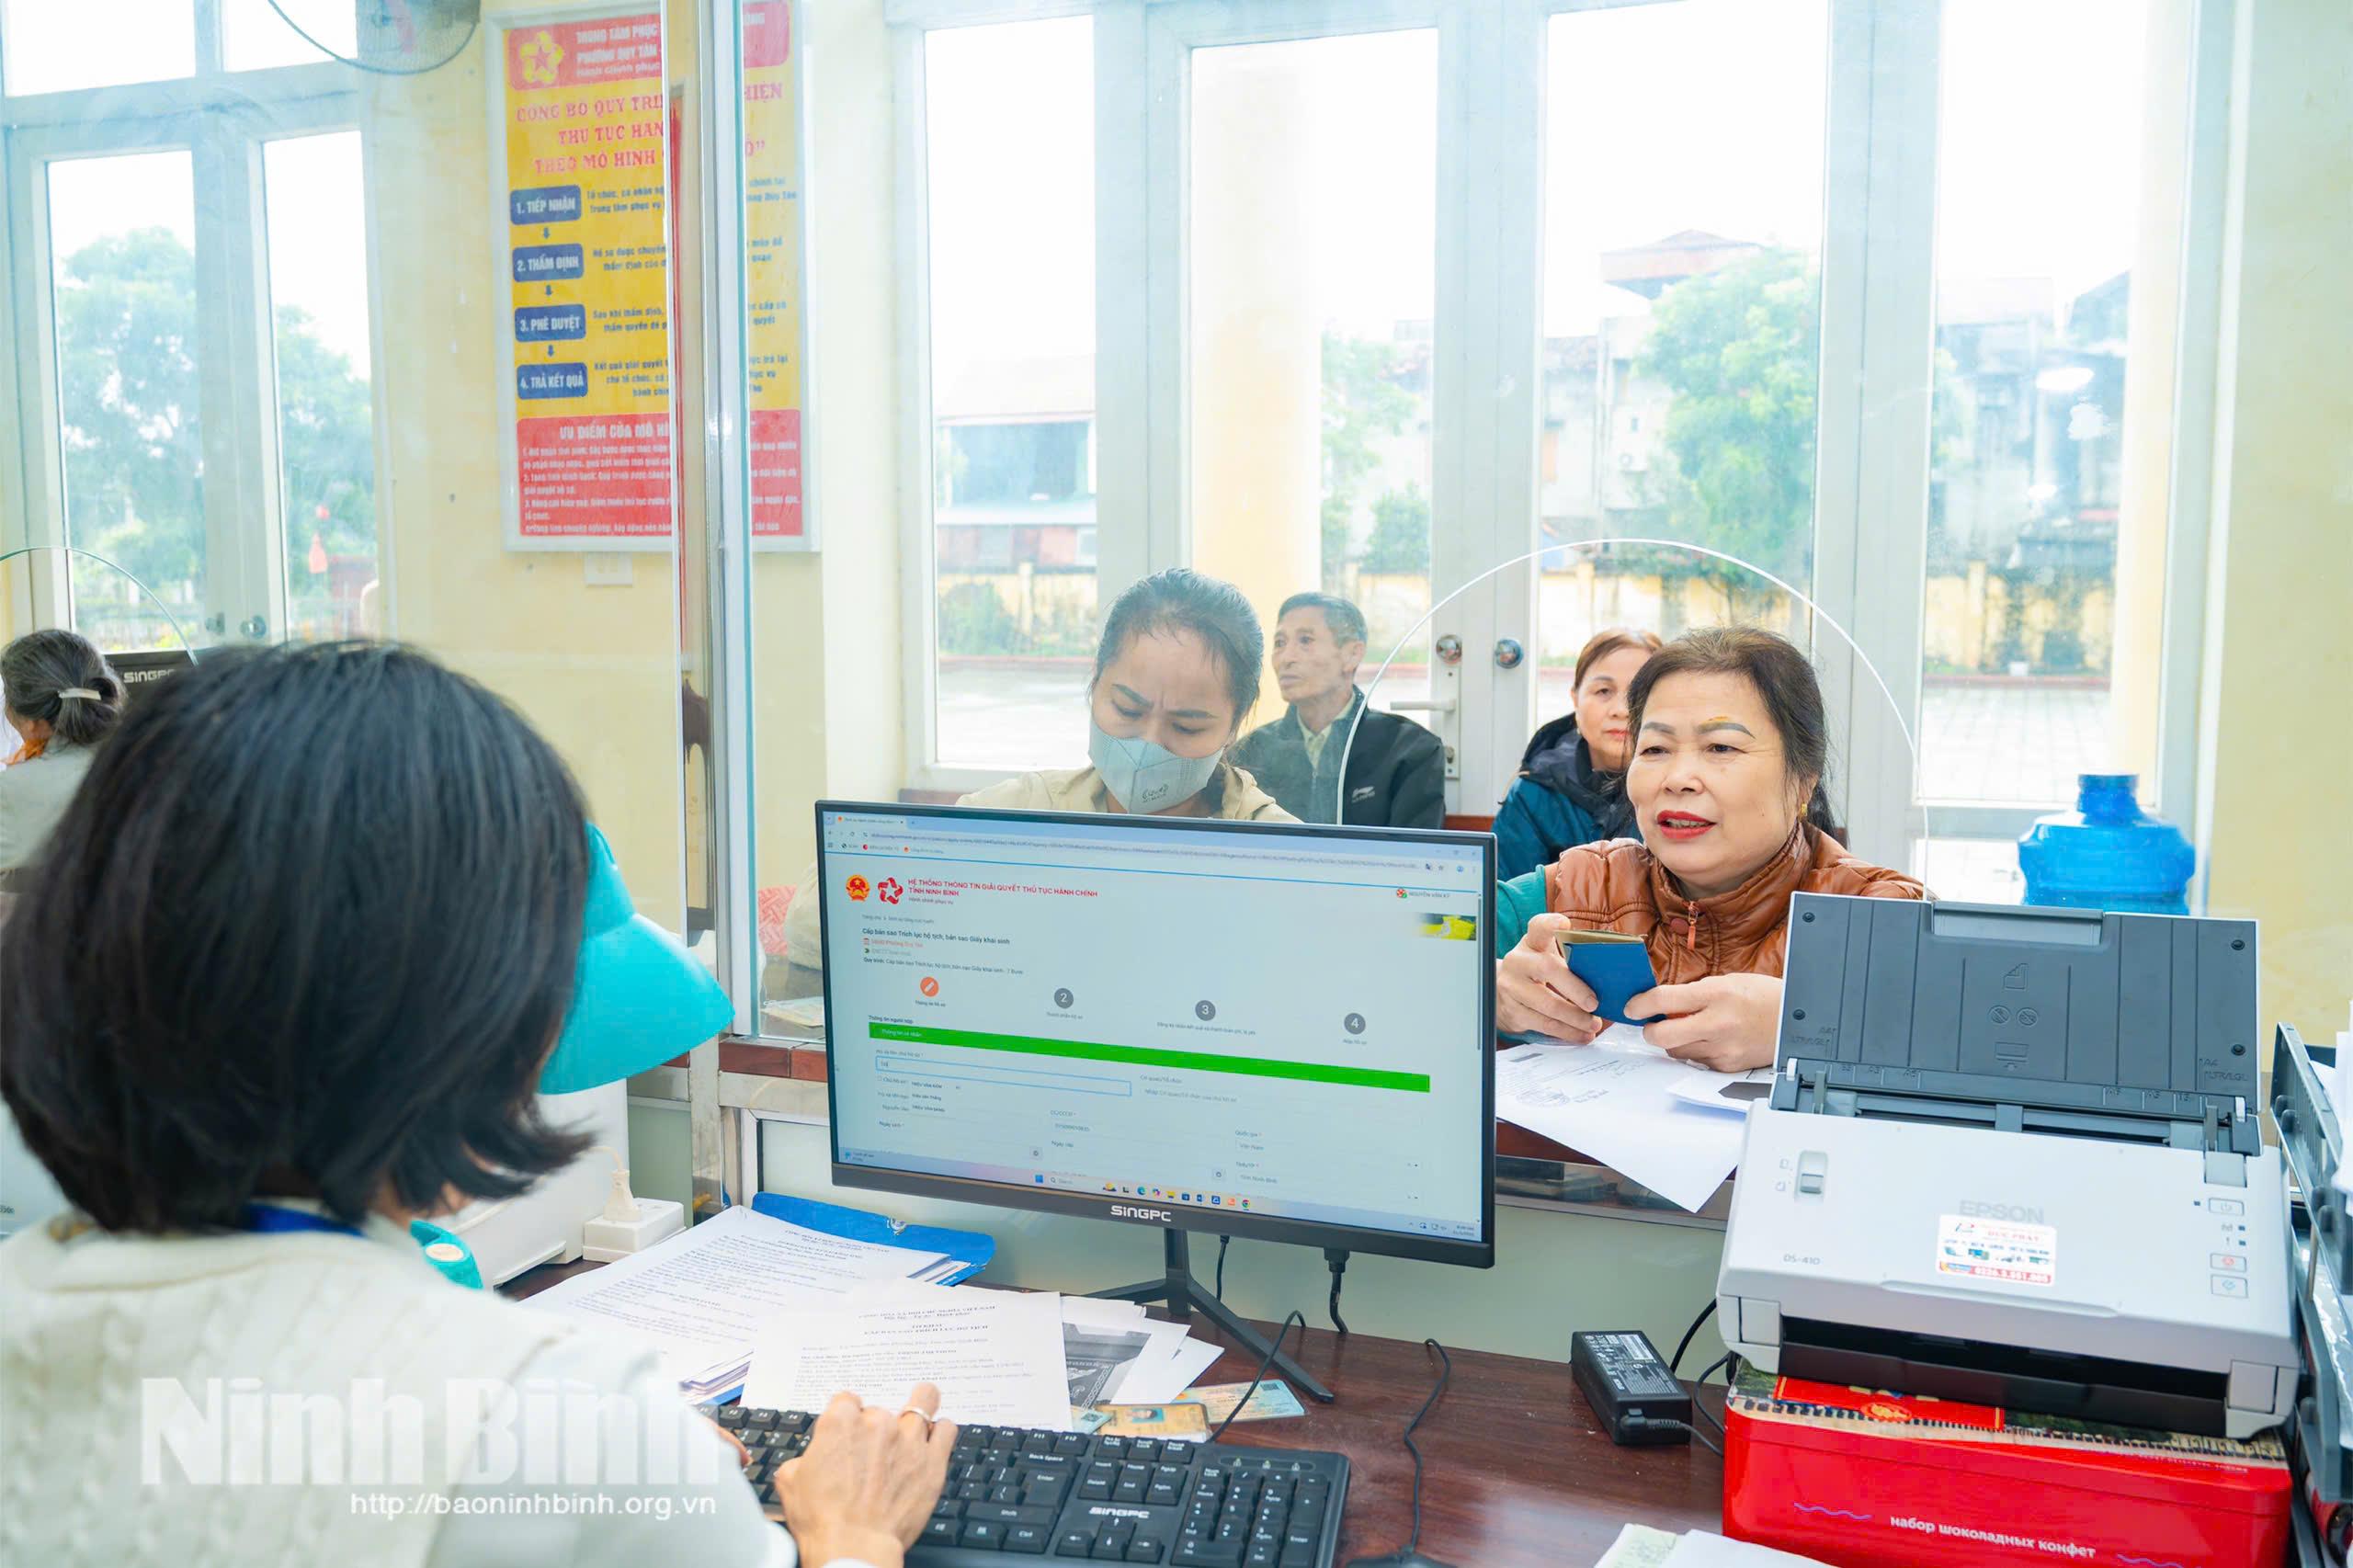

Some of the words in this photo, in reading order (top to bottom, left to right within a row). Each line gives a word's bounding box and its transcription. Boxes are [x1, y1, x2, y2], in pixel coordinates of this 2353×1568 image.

[527, 197, 547, 214] TIẾP
[549, 196, 576, 212] NHẬN
[517, 260, 527, 273] 2.
[519, 320, 529, 333] 3.
[566, 369, 585, 388] QUẢ
[970, 881, 981, 890] TIN
[997, 883, 1020, 892] QUYẾT
[1060, 993, 1068, 1004] 2
[1201, 1004, 1210, 1015] 3
[1351, 1017, 1359, 1028] 4
[1959, 1199, 2044, 1224] EPSON
[1783, 1254, 1821, 1266] DS-410
[1890, 1516, 1936, 1534] набор
[1938, 1522, 2035, 1550] шоколадных
[2038, 1537, 2097, 1559] конфет
